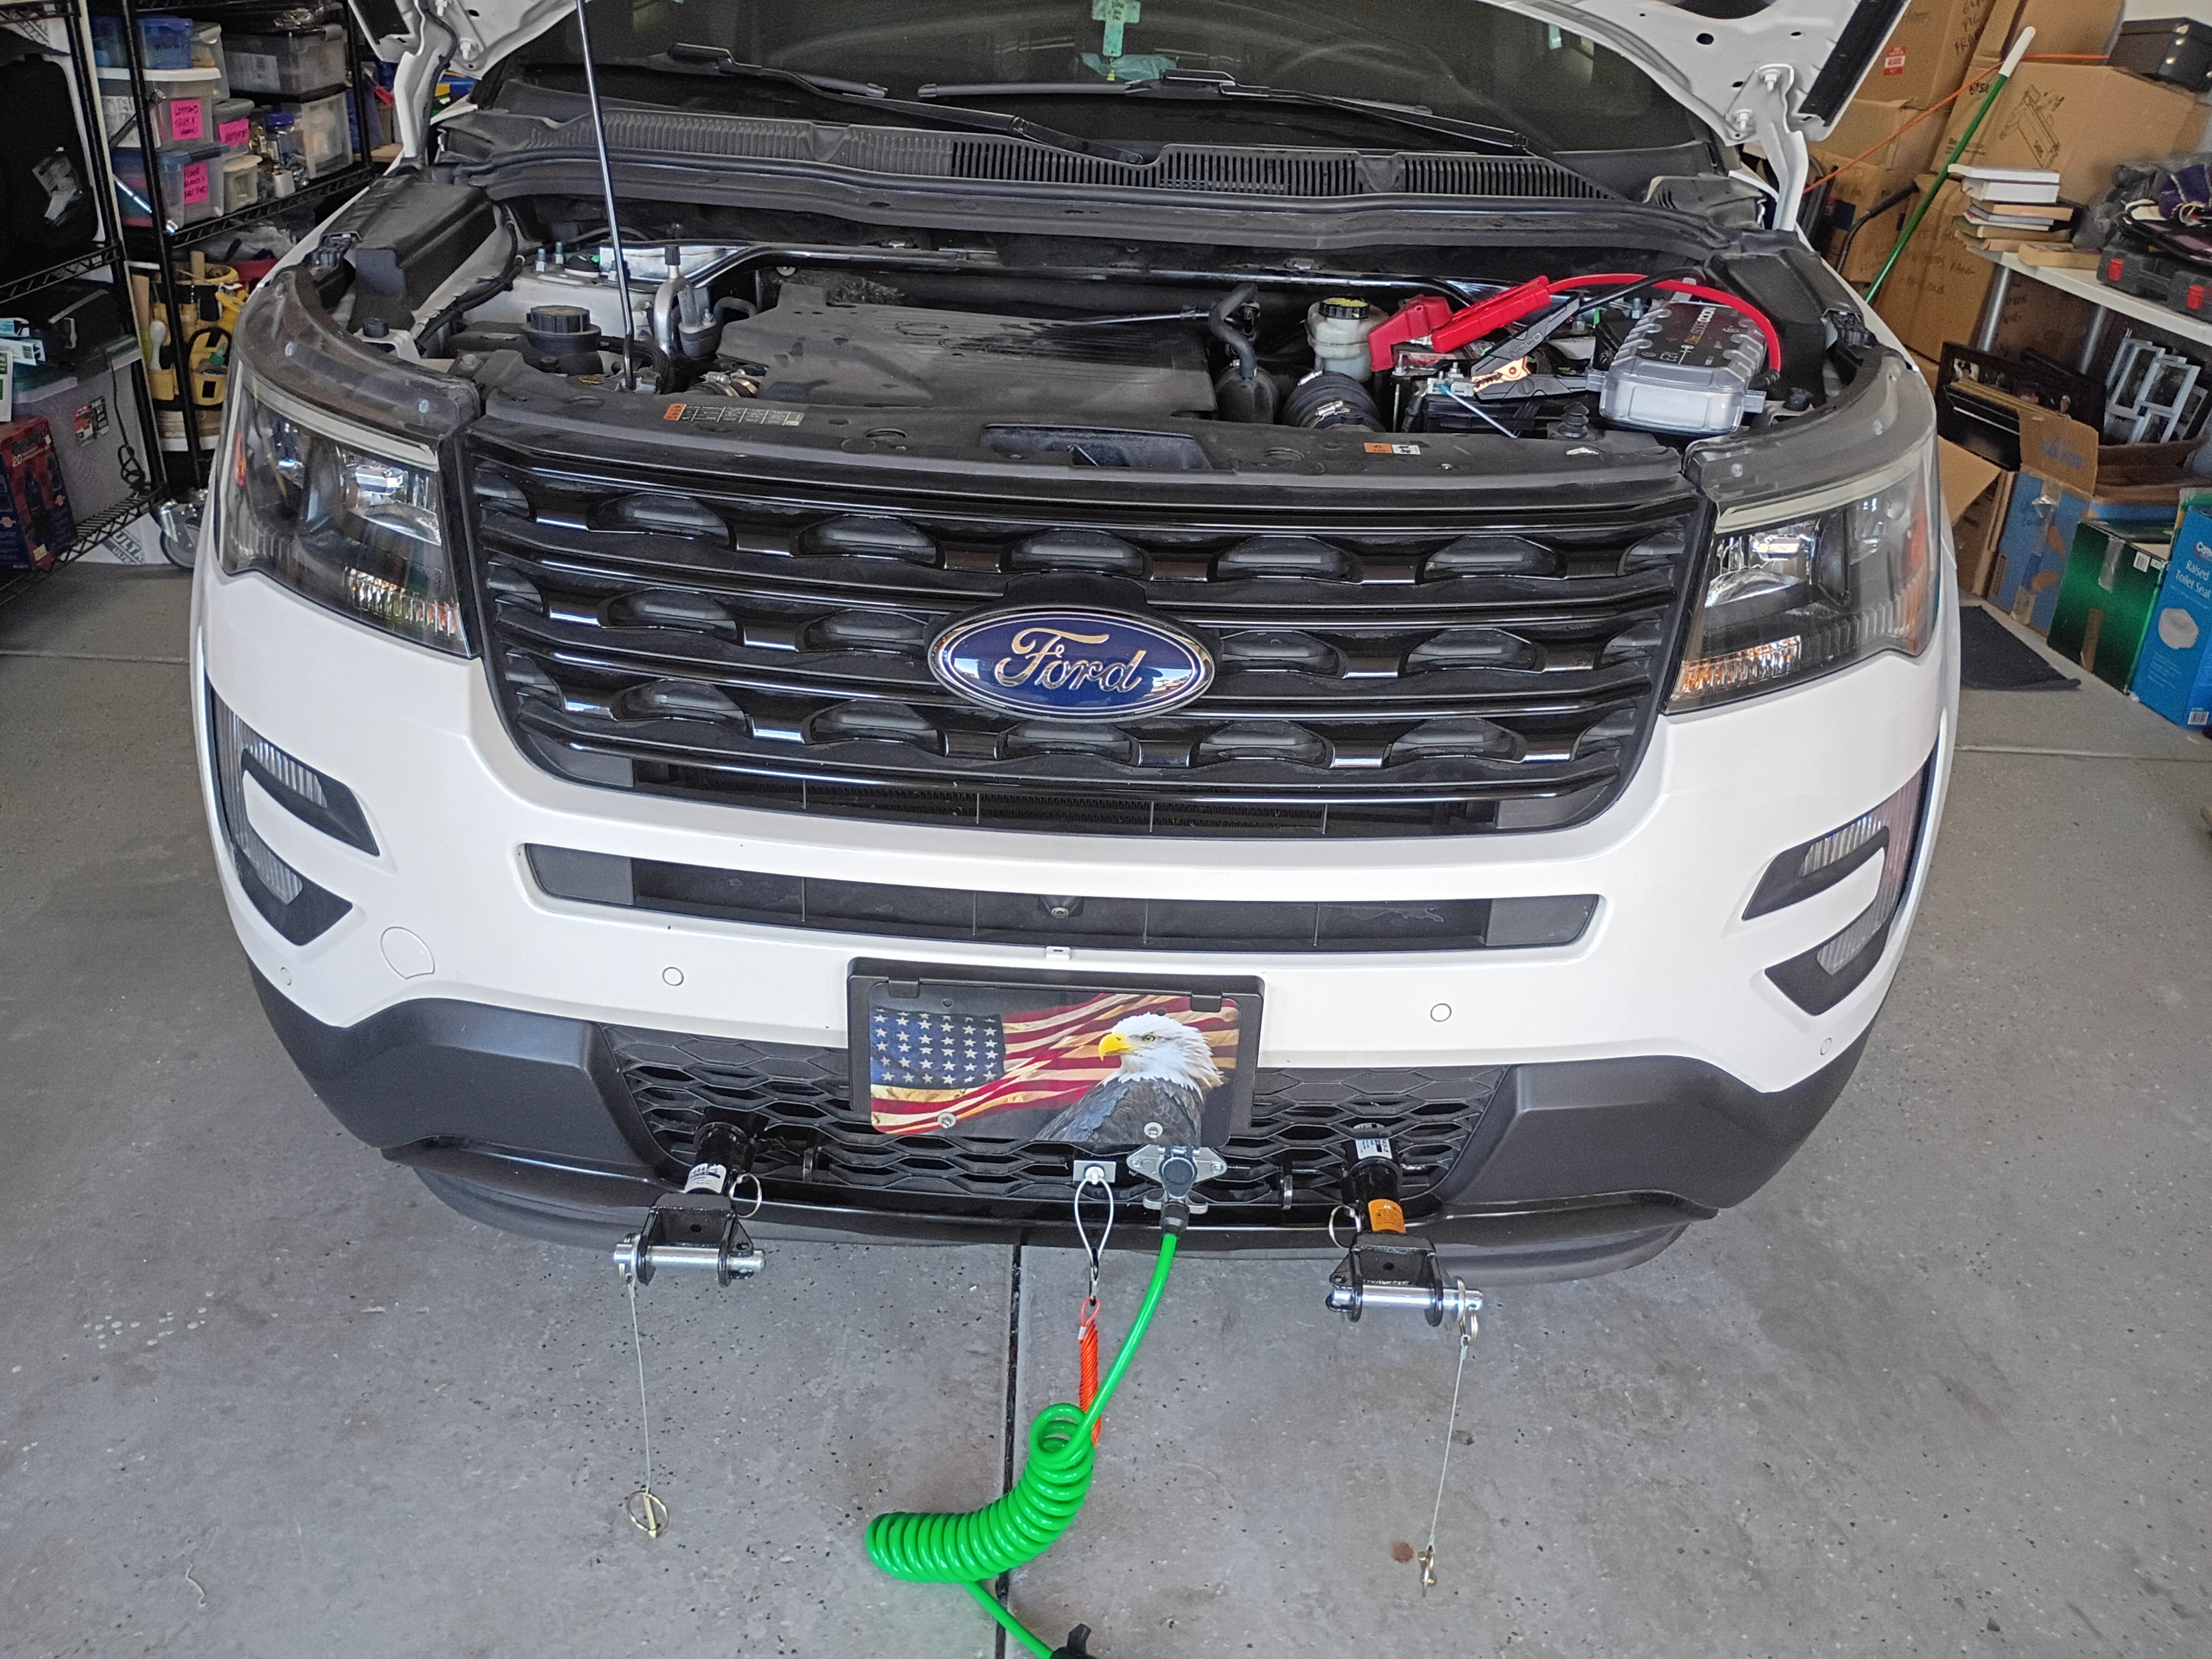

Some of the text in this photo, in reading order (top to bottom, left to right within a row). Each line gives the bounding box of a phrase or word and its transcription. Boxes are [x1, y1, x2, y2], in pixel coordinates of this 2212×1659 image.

[1508, 332, 1542, 358] NOCO
[12, 454, 22, 467] 20
[2185, 560, 2210, 581] Raised
[2176, 569, 2195, 589] Toilet
[2195, 582, 2211, 599] Seat
[995, 627, 1148, 693] Ford
